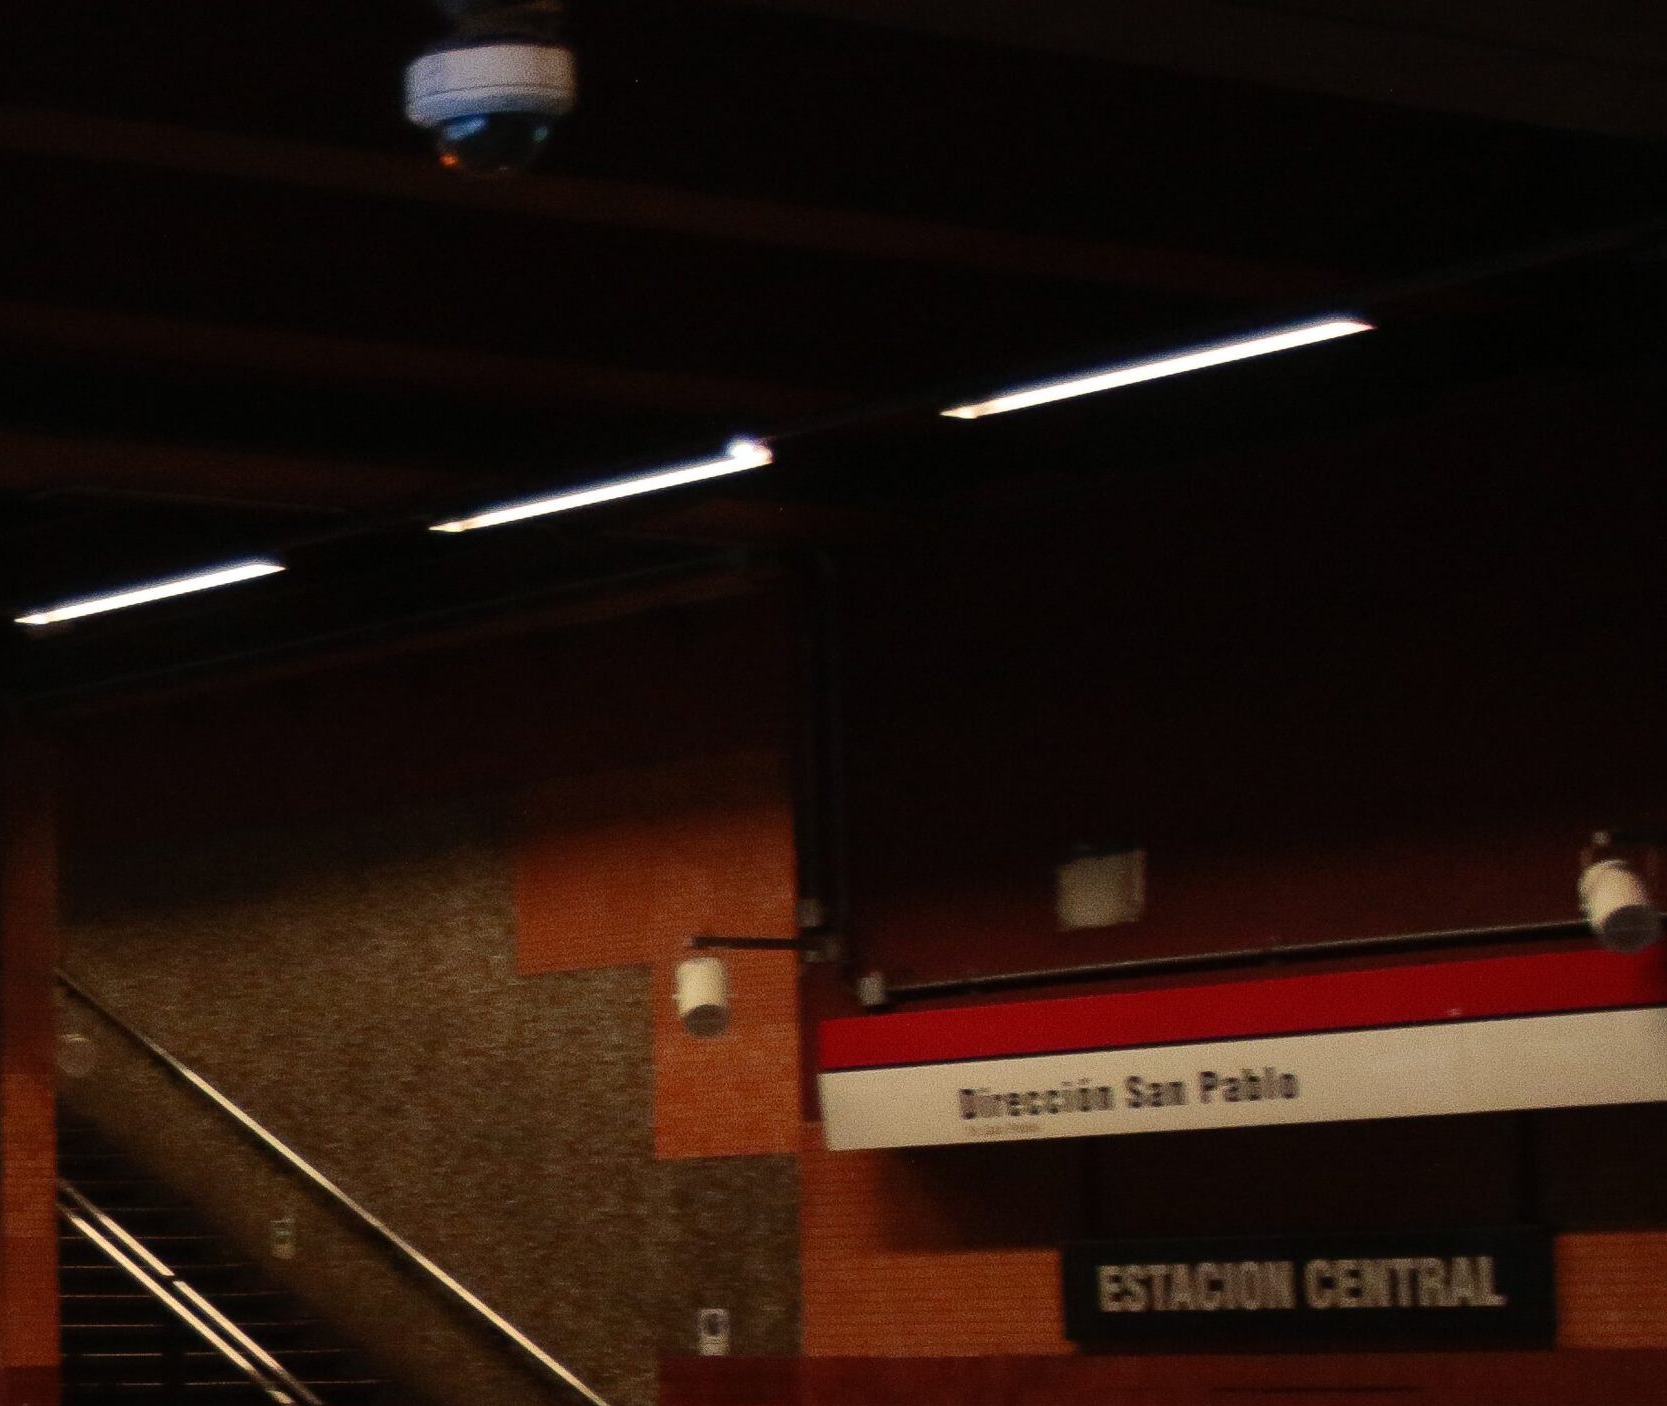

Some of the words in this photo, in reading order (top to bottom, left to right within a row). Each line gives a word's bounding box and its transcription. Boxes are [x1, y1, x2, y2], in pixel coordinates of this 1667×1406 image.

[959, 1079, 1114, 1121] Dirección
[1124, 1075, 1189, 1109] San
[1199, 1066, 1300, 1104] Pablo
[1097, 1259, 1296, 1313] ESTACION
[1304, 1256, 1508, 1310] CENTRAL
